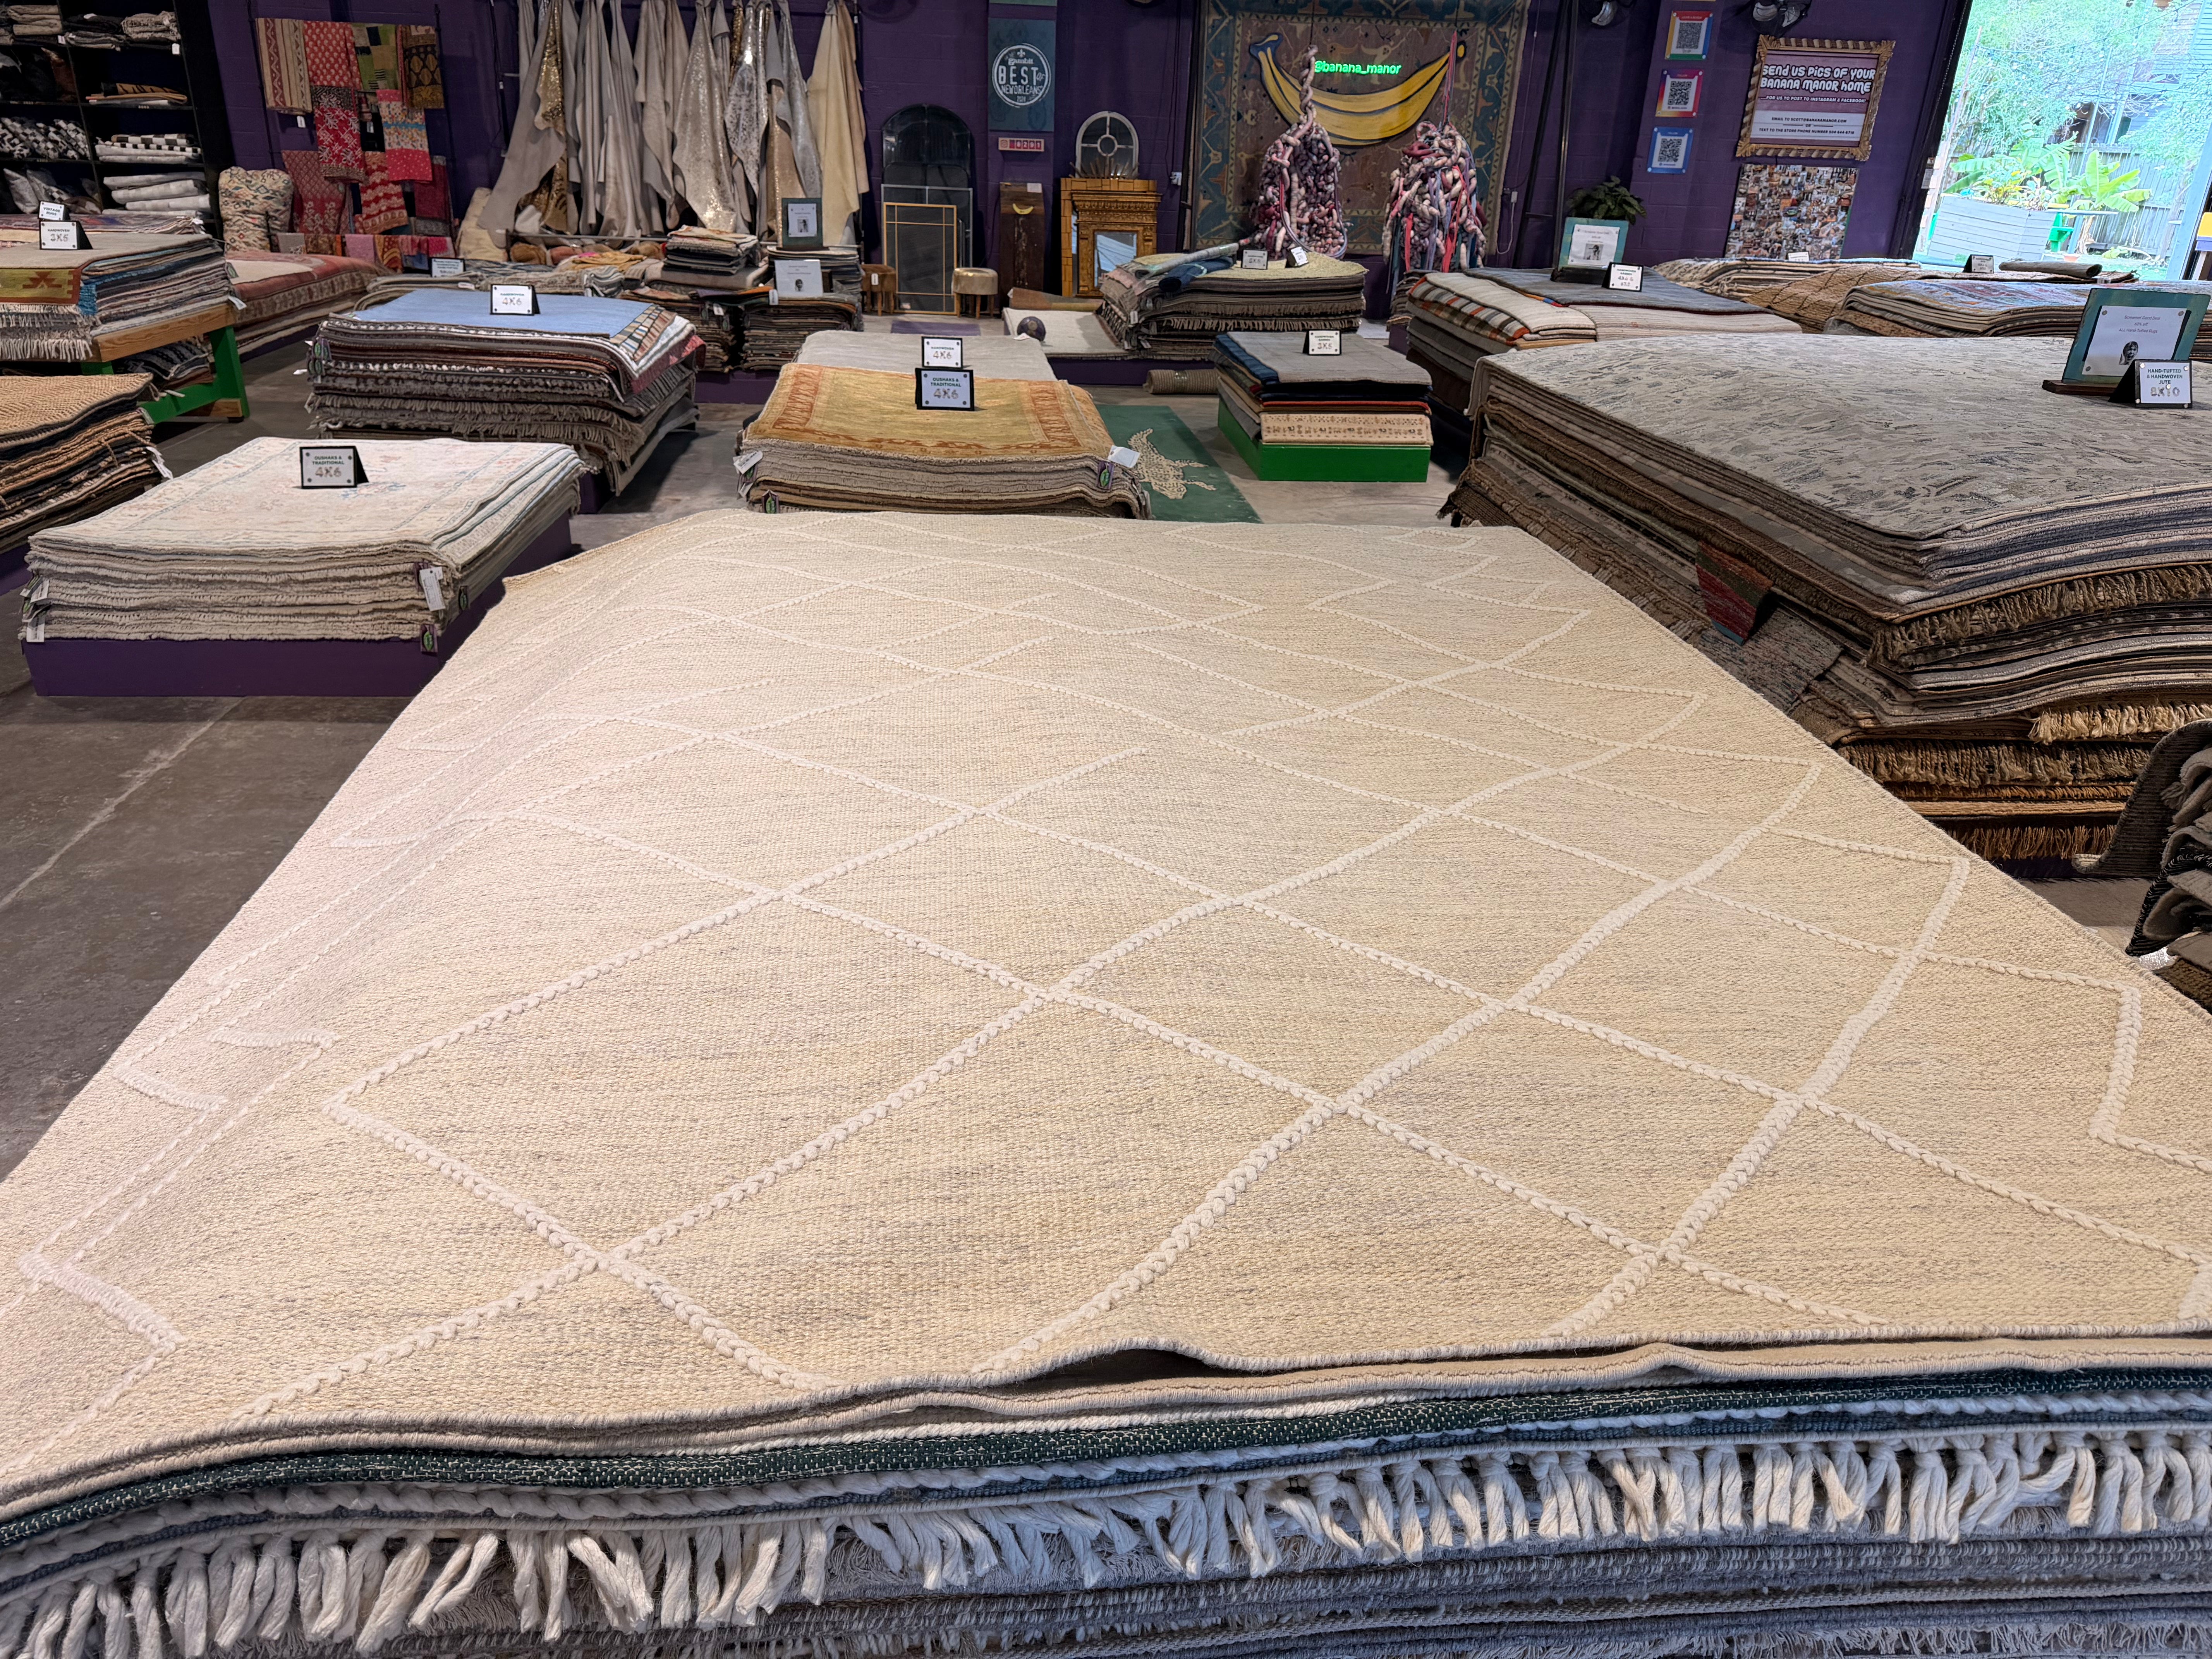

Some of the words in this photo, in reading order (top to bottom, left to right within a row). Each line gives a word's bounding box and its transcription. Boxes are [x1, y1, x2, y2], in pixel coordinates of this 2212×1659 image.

[1315, 60, 1401, 74] @banana_manor
[998, 65, 1039, 86] BEST
[1036, 72, 1045, 81] OF
[1791, 65, 1806, 77] US
[1833, 67, 1849, 79] OF
[1850, 67, 1876, 81] YOUR
[502, 297, 522, 306] 4X6
[933, 351, 952, 359] 4X6
[934, 388, 959, 399] 4X6
[2150, 387, 2180, 397] 8X10
[315, 466, 342, 477] 4X6
